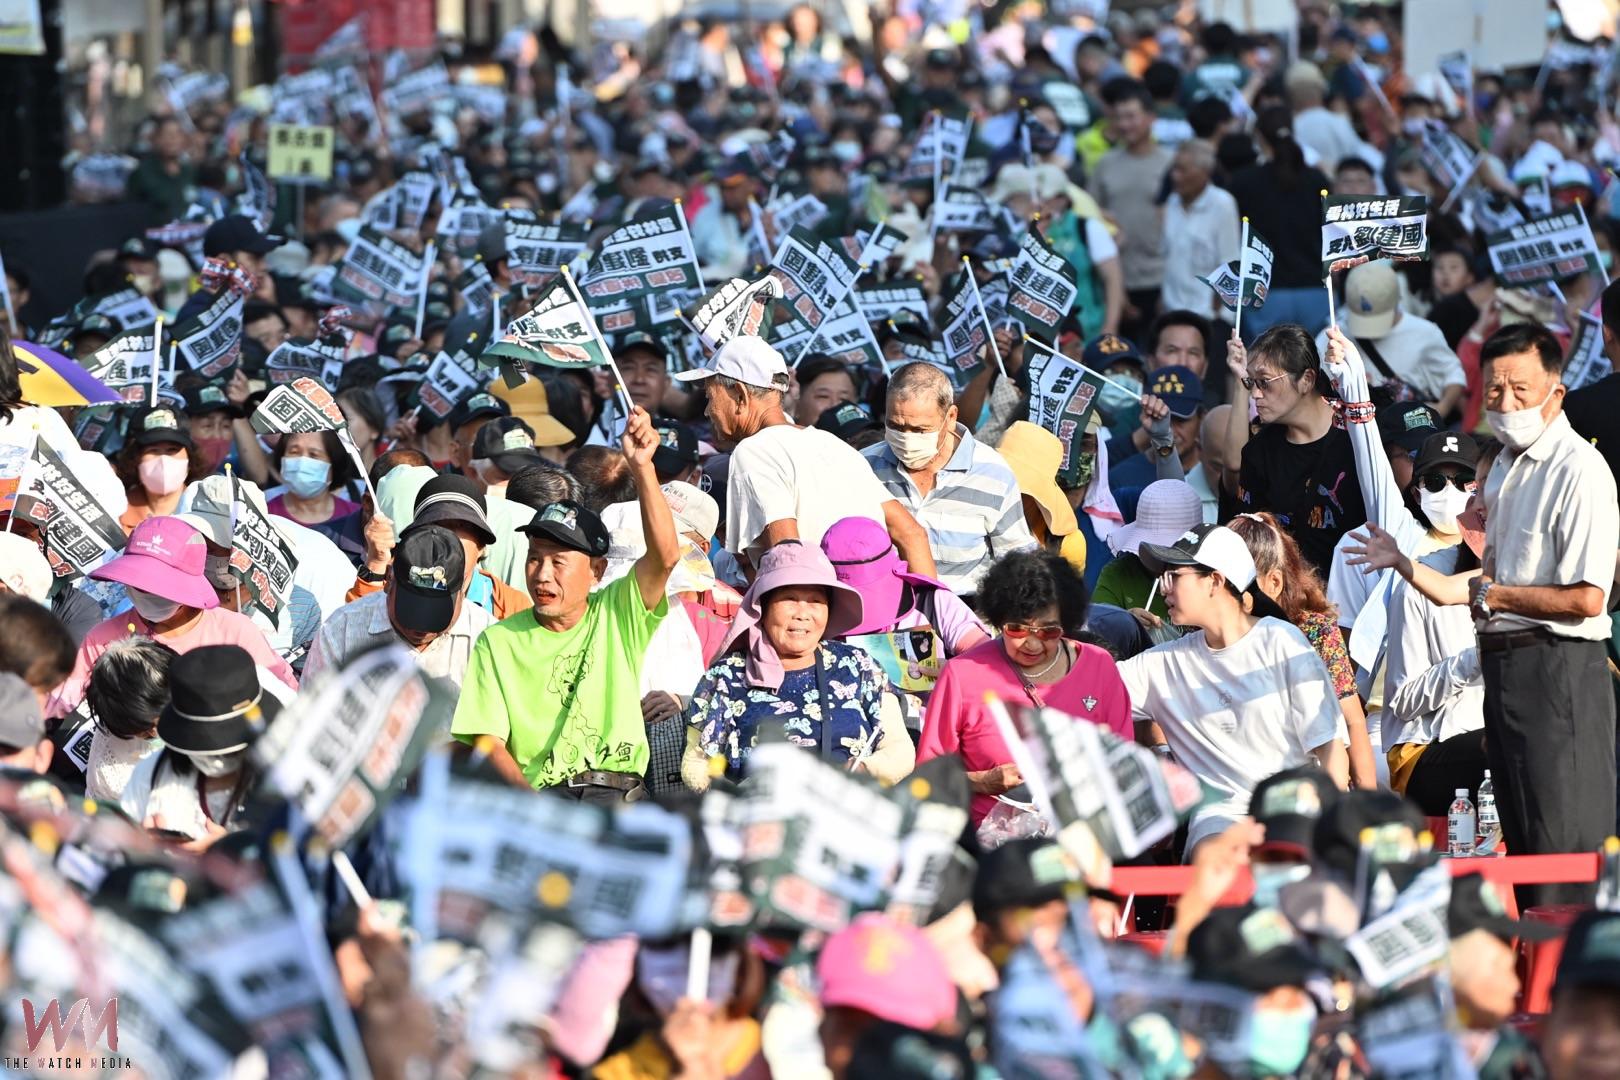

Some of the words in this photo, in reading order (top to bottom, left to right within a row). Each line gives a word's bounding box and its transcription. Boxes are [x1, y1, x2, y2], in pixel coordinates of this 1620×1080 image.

[1326, 199, 1400, 222] 雲林好生活
